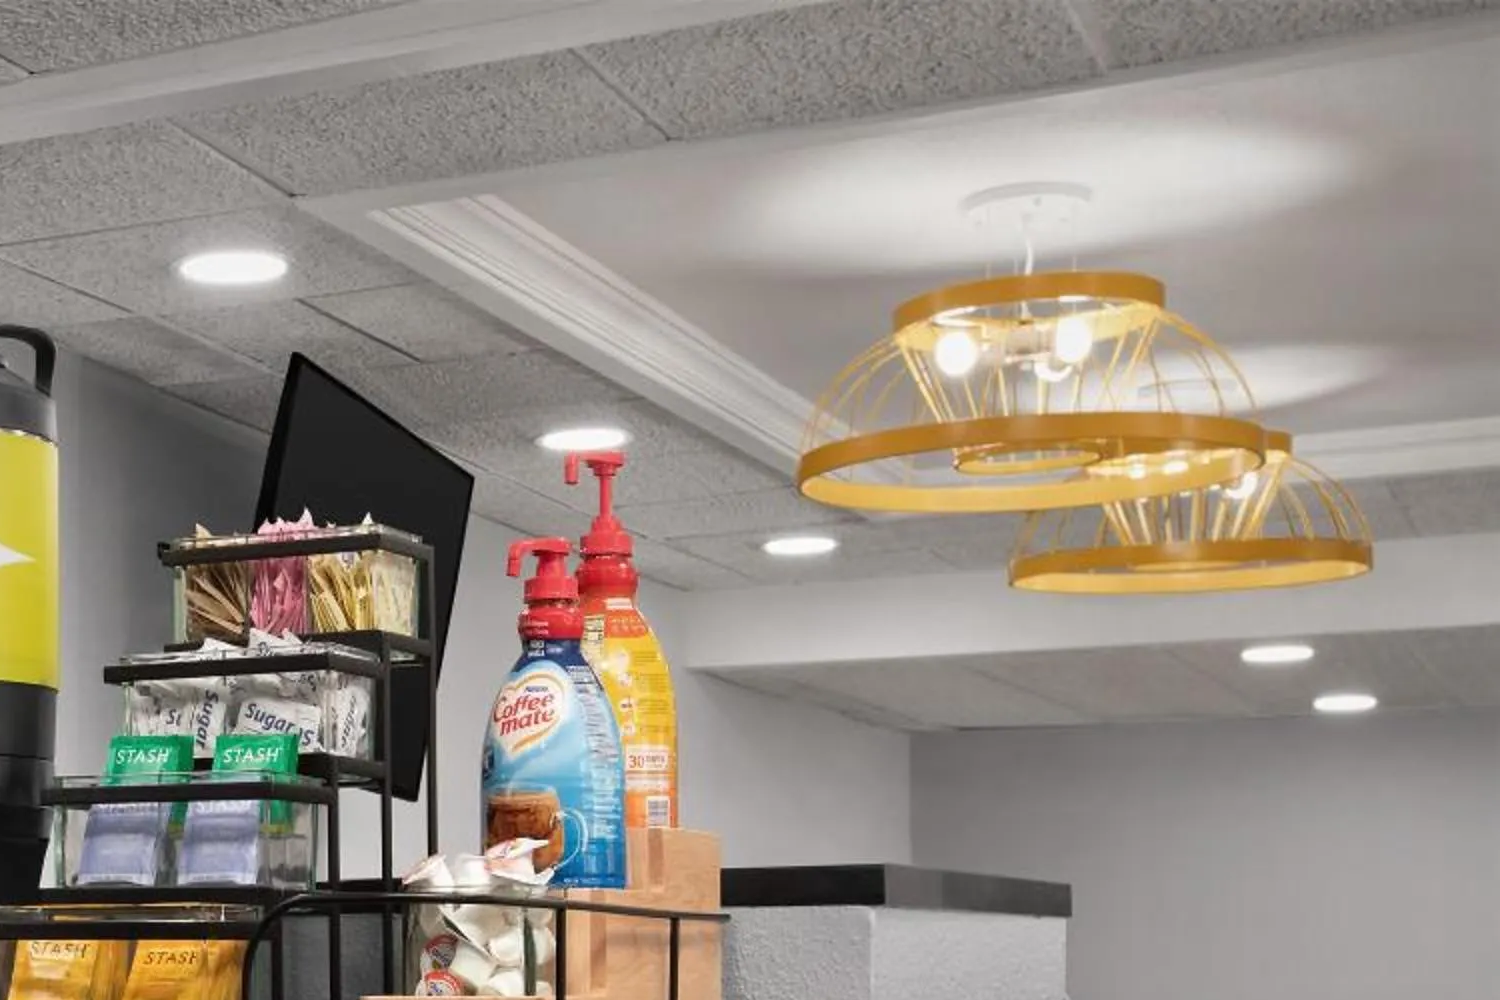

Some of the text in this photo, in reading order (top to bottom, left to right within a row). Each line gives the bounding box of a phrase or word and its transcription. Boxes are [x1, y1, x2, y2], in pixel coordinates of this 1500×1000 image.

[195, 689, 220, 749] Sugar
[244, 703, 296, 734] Sugar
[493, 693, 555, 722] Coffee
[500, 709, 555, 737] mate
[116, 748, 169, 765] STASH
[223, 747, 279, 764] STASH
[30, 941, 88, 959] STASH
